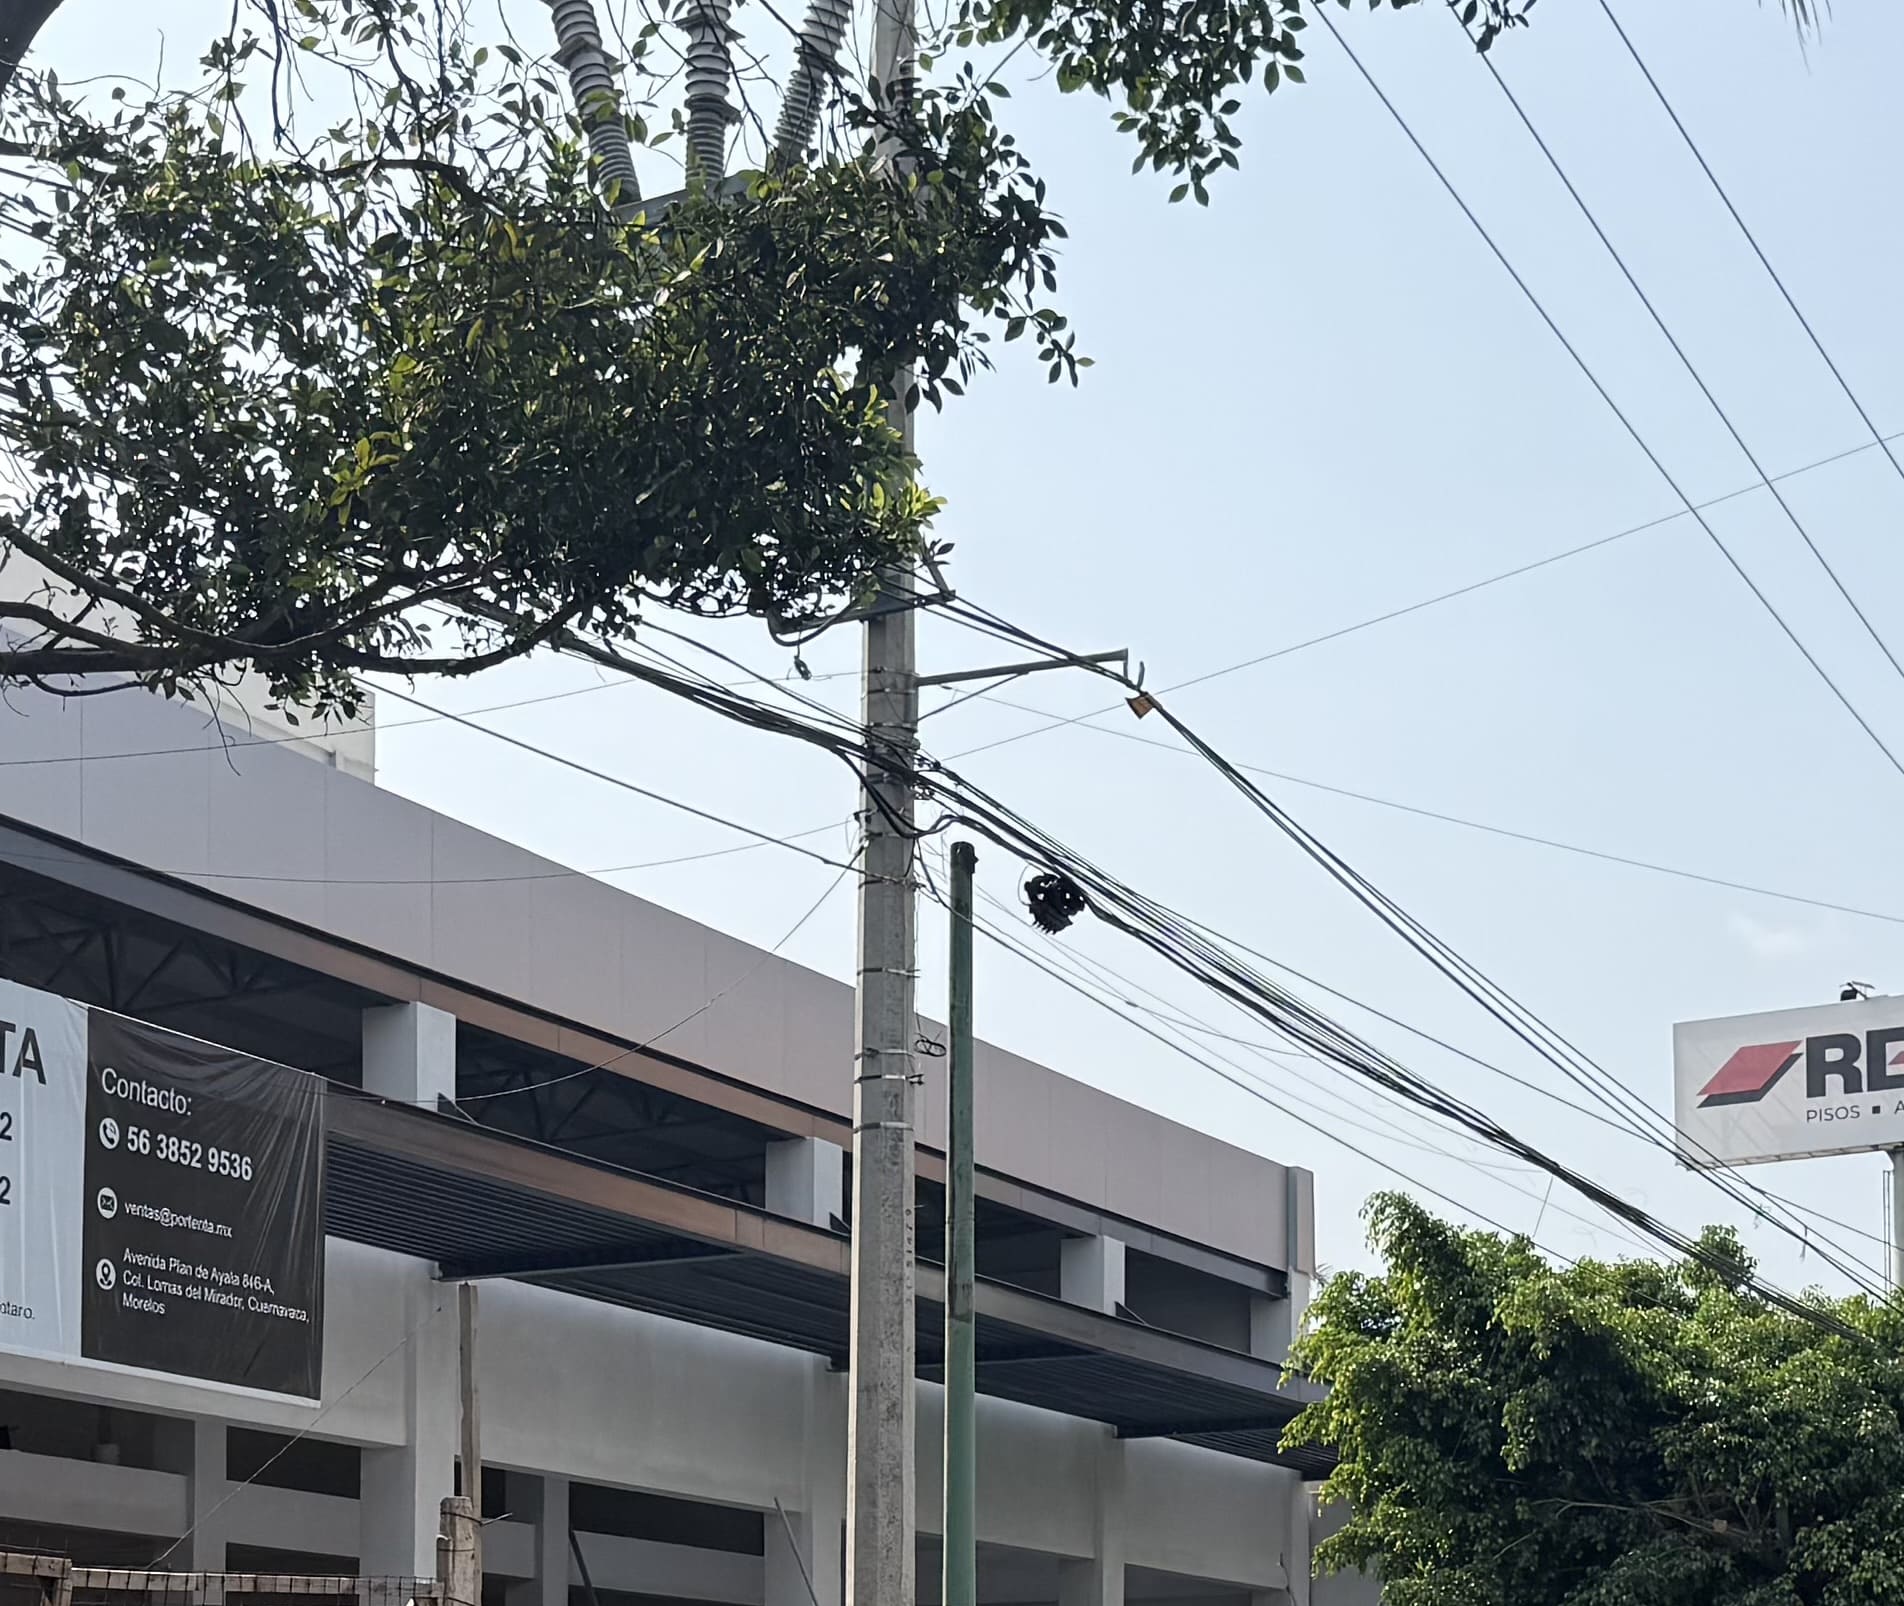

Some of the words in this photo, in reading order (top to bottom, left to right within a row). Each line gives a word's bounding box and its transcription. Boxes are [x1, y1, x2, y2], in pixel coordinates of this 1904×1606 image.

[102, 1067, 192, 1116] Contacto:
[1806, 1104, 1861, 1123] PISOS
[127, 1125, 151, 1155] 56
[156, 1133, 202, 1169] 3852
[208, 1147, 253, 1181] 9536
[123, 1247, 167, 1271] Avenida
[169, 1256, 193, 1276] Plan
[195, 1263, 209, 1280] de
[211, 1266, 240, 1289] Ayala
[123, 1269, 145, 1289] Col.
[147, 1277, 183, 1296] Lomas
[185, 1283, 202, 1300] del
[123, 1291, 166, 1315] Morelos
